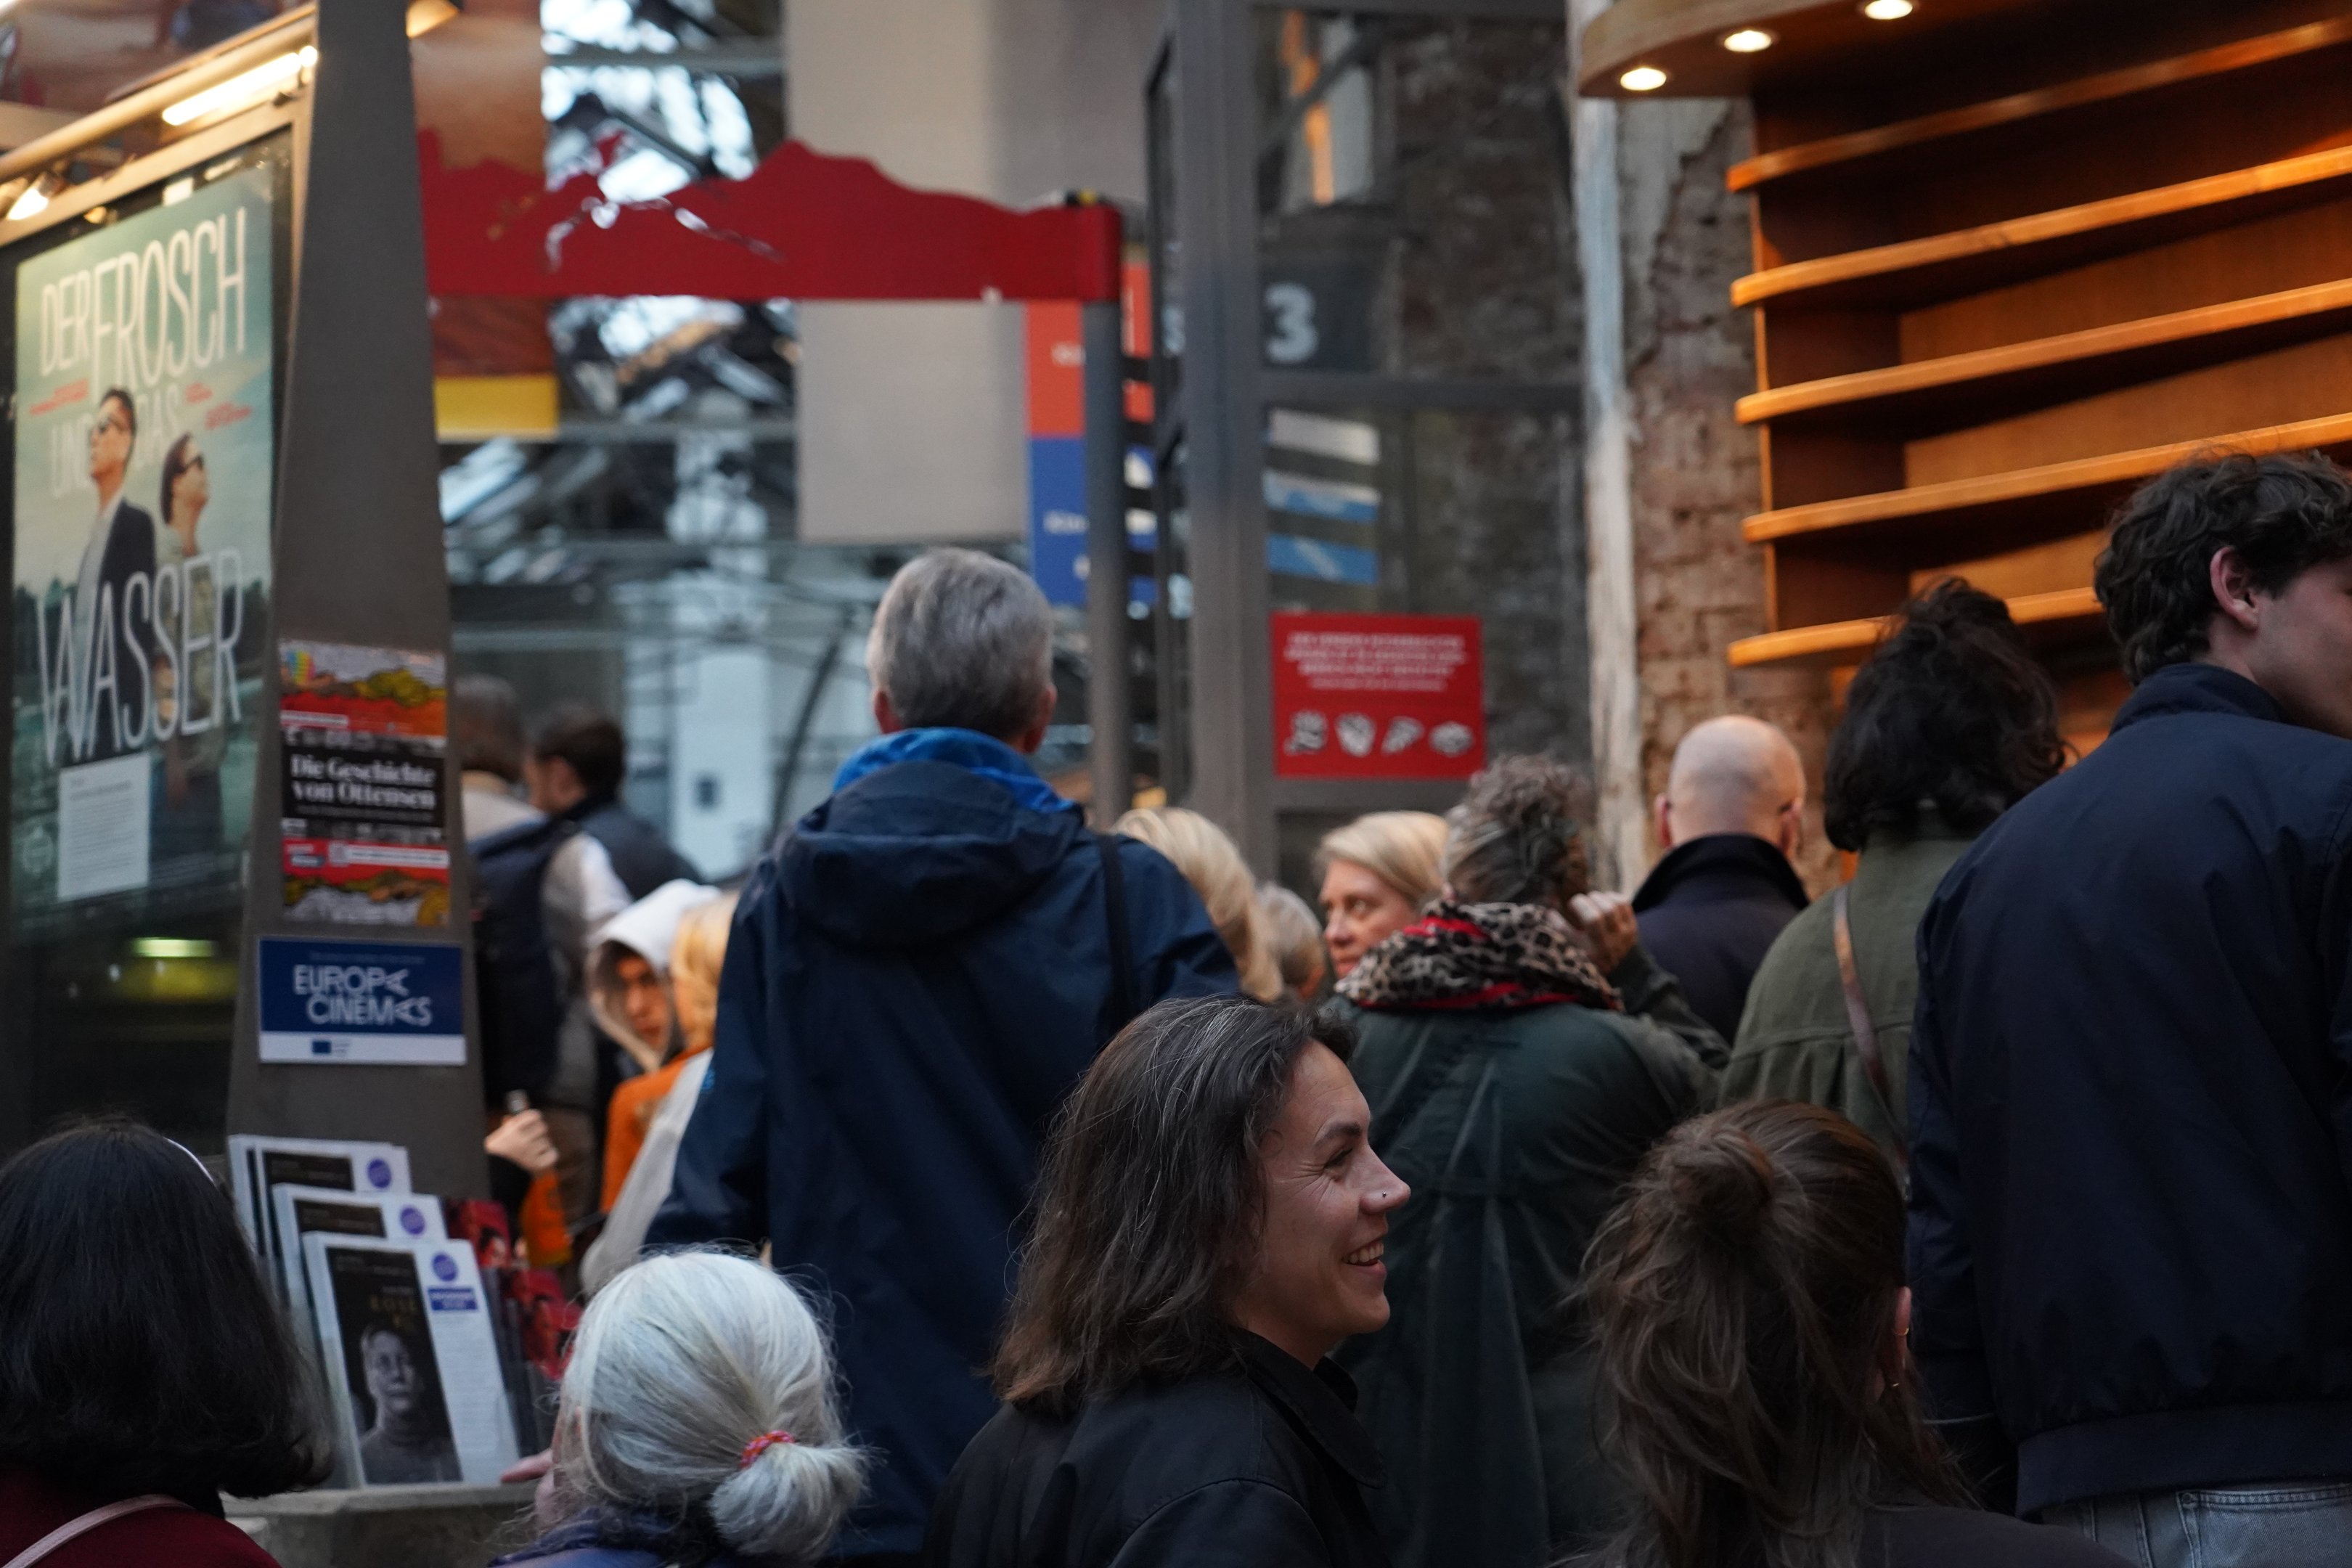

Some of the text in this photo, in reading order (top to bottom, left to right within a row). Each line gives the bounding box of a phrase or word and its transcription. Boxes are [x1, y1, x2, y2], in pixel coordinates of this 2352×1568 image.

[41, 206, 246, 407] DER FROSCH
[1265, 283, 1317, 363] 3
[37, 547, 243, 768] WASSER
[292, 754, 325, 779] Die
[293, 780, 334, 801] von
